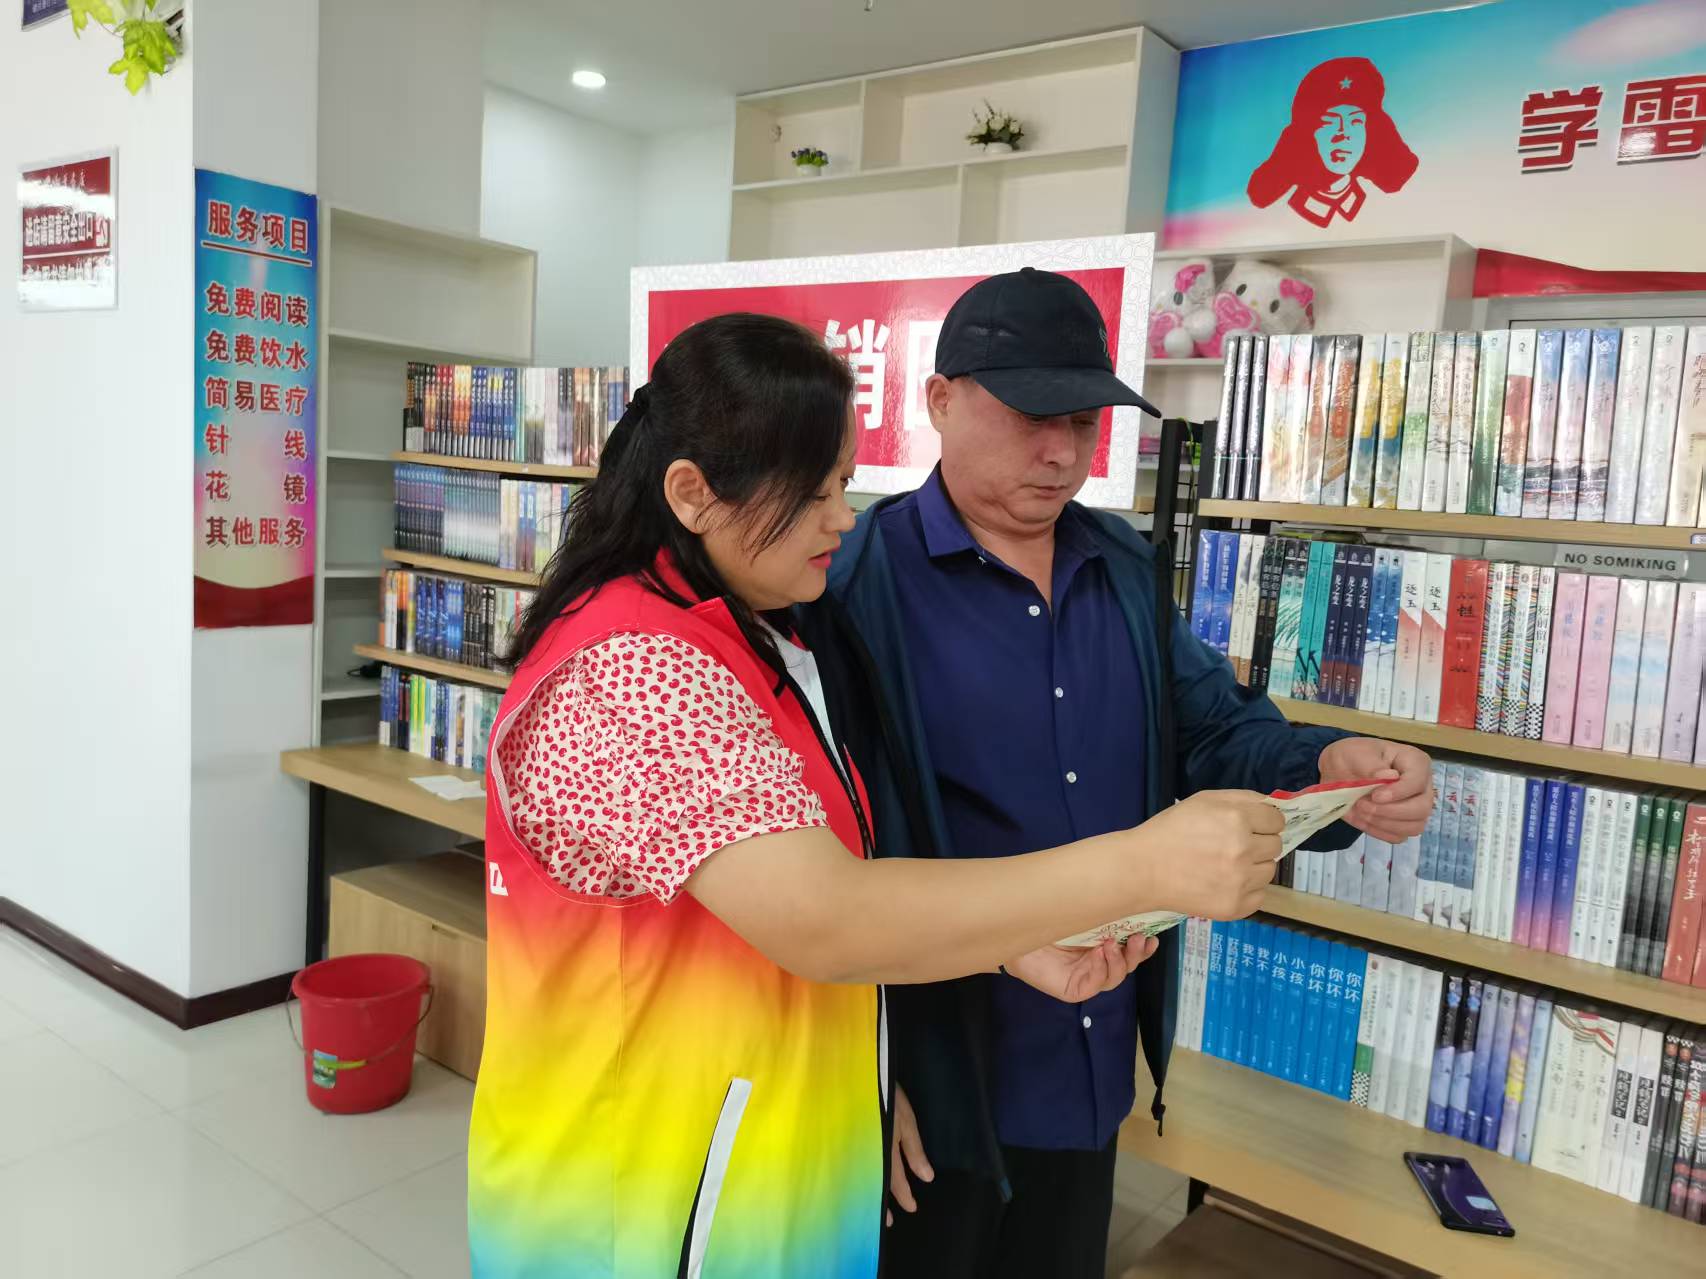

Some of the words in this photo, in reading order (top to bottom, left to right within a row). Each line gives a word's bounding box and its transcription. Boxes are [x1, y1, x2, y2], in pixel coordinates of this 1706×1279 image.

[1519, 75, 1706, 173] 学雷
[208, 199, 309, 253] 服务项目
[206, 281, 309, 327] 免费阅读
[206, 329, 309, 371] 免费饮水
[206, 376, 308, 416] 简易医疗
[206, 424, 230, 456] 针
[283, 429, 307, 460] 线
[206, 470, 231, 501] 花
[283, 473, 307, 504] 镜
[206, 515, 306, 548] 其他服务
[1564, 552, 1588, 565] NO
[1593, 555, 1677, 572] SOMIKING
[1241, 942, 1255, 968] 我不
[1256, 946, 1270, 972] 我不
[1272, 951, 1288, 981] 小孩
[1289, 956, 1305, 986] 小孩
[1308, 962, 1326, 993] 你坏
[1326, 967, 1344, 998] 你坏
[1344, 971, 1362, 1003] 你坏
